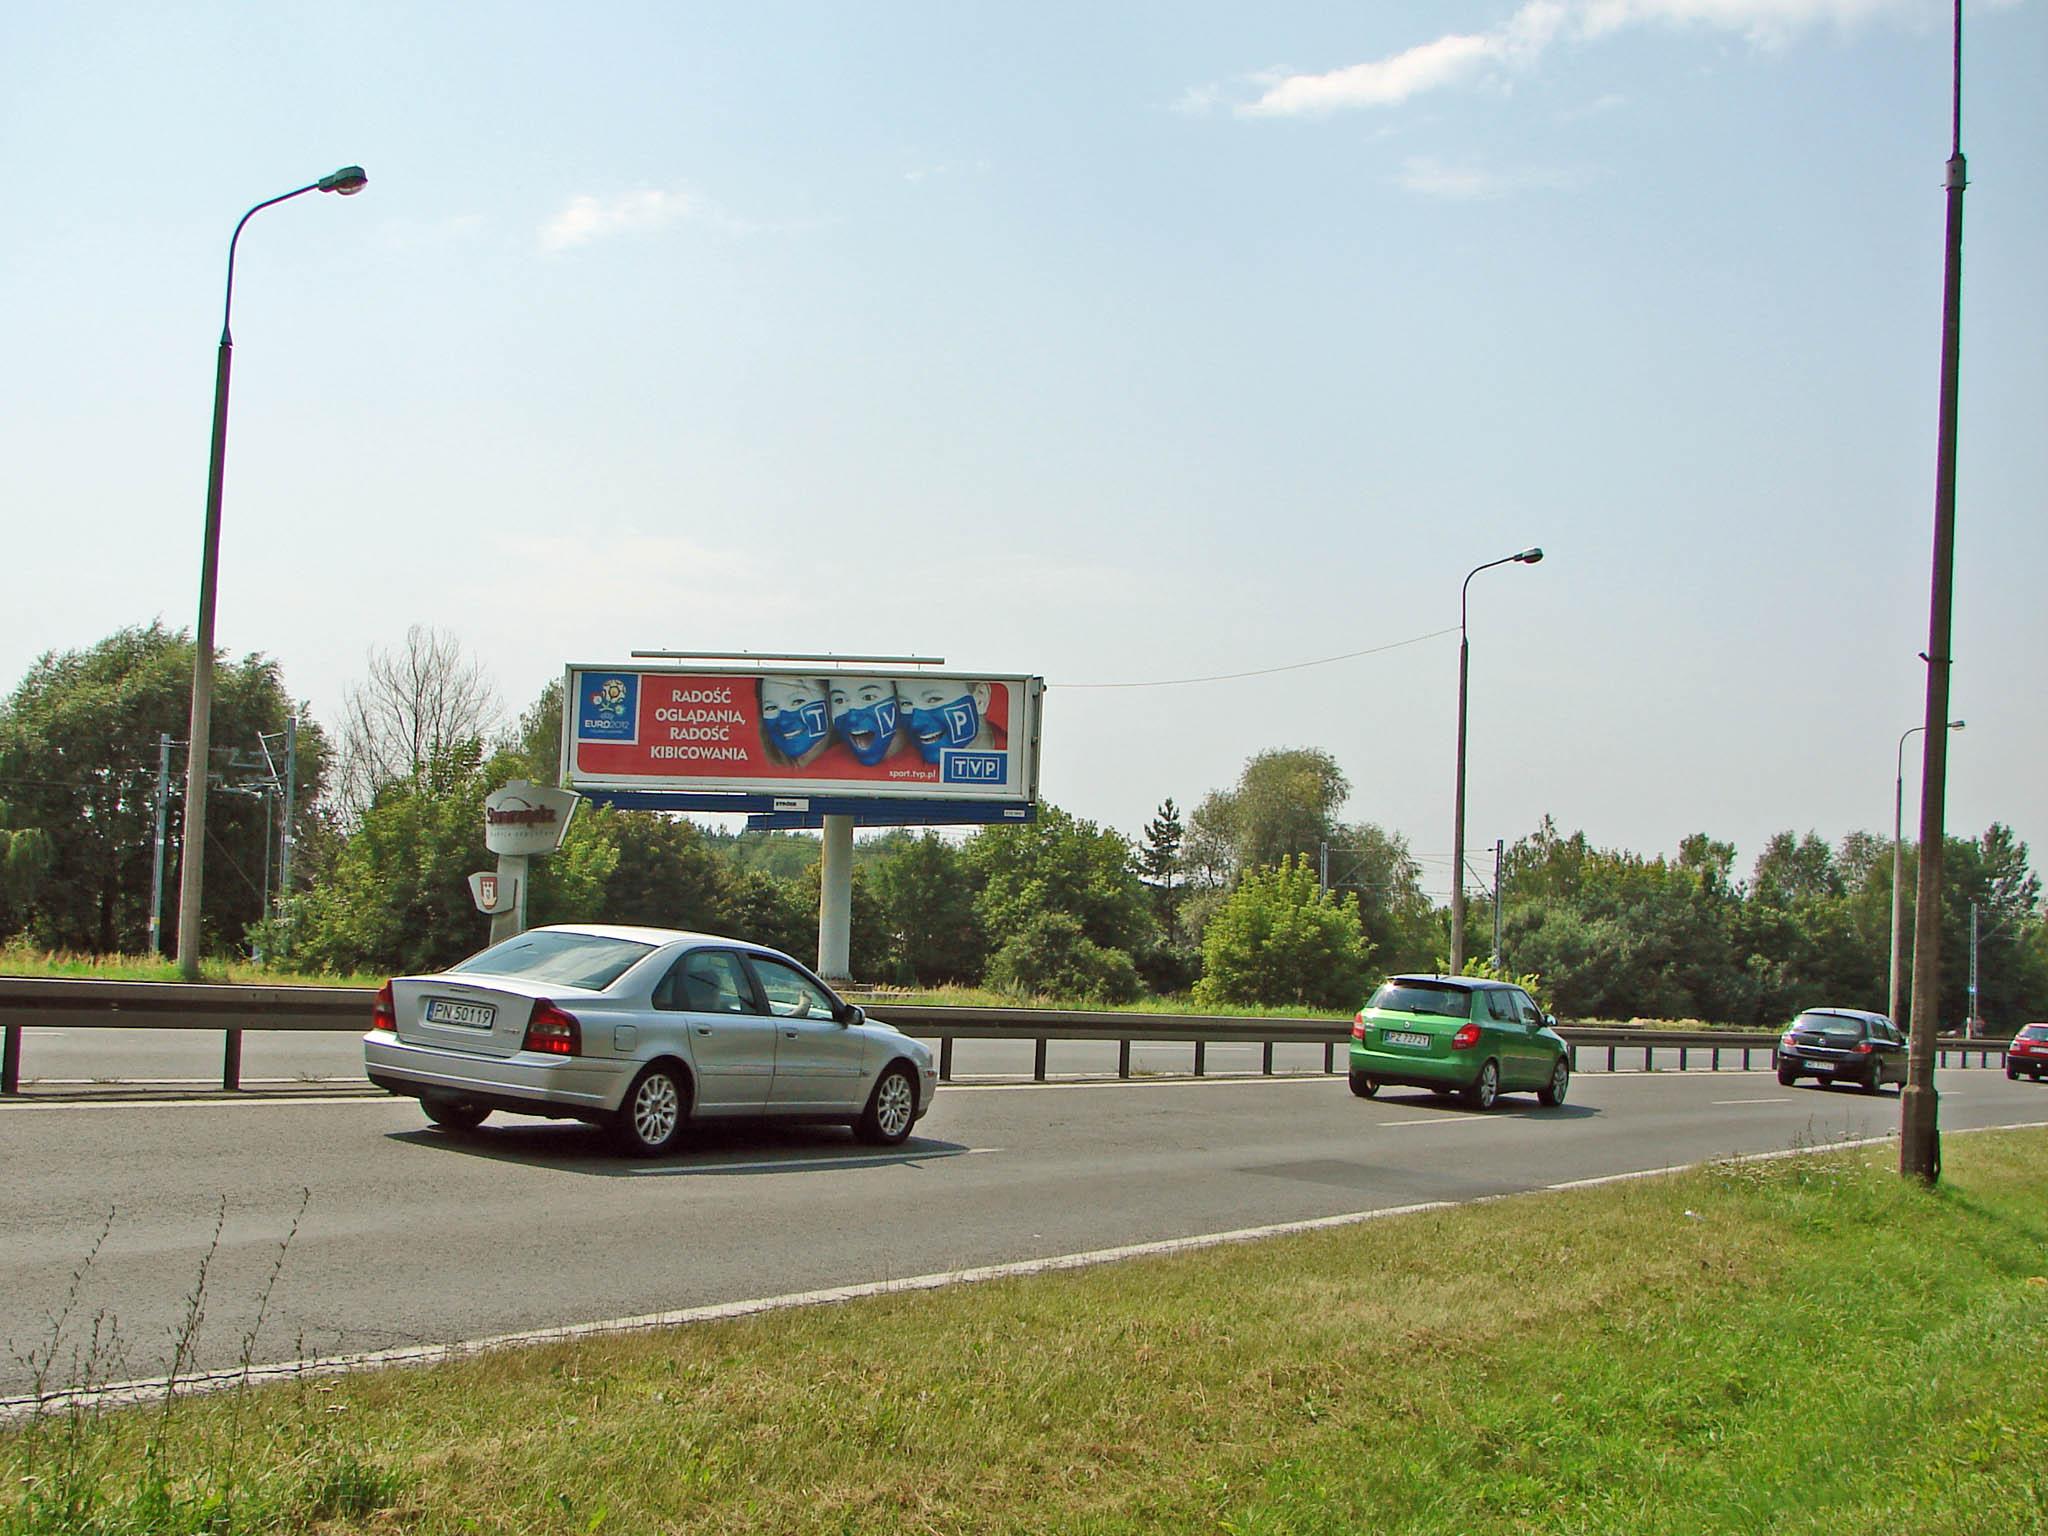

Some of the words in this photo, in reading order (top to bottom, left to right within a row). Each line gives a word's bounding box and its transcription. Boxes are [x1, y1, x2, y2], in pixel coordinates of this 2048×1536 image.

[672, 688, 731, 703] RADOŚĆ
[655, 708, 746, 725] OGLĄDANIA,
[670, 725, 730, 741] RADOŚĆ
[650, 746, 748, 760] KIBICOWANIA
[889, 769, 936, 779] sport.tvp.pl
[955, 761, 996, 776] TVP
[434, 1003, 453, 1019] PN
[454, 1006, 491, 1024] 50119
